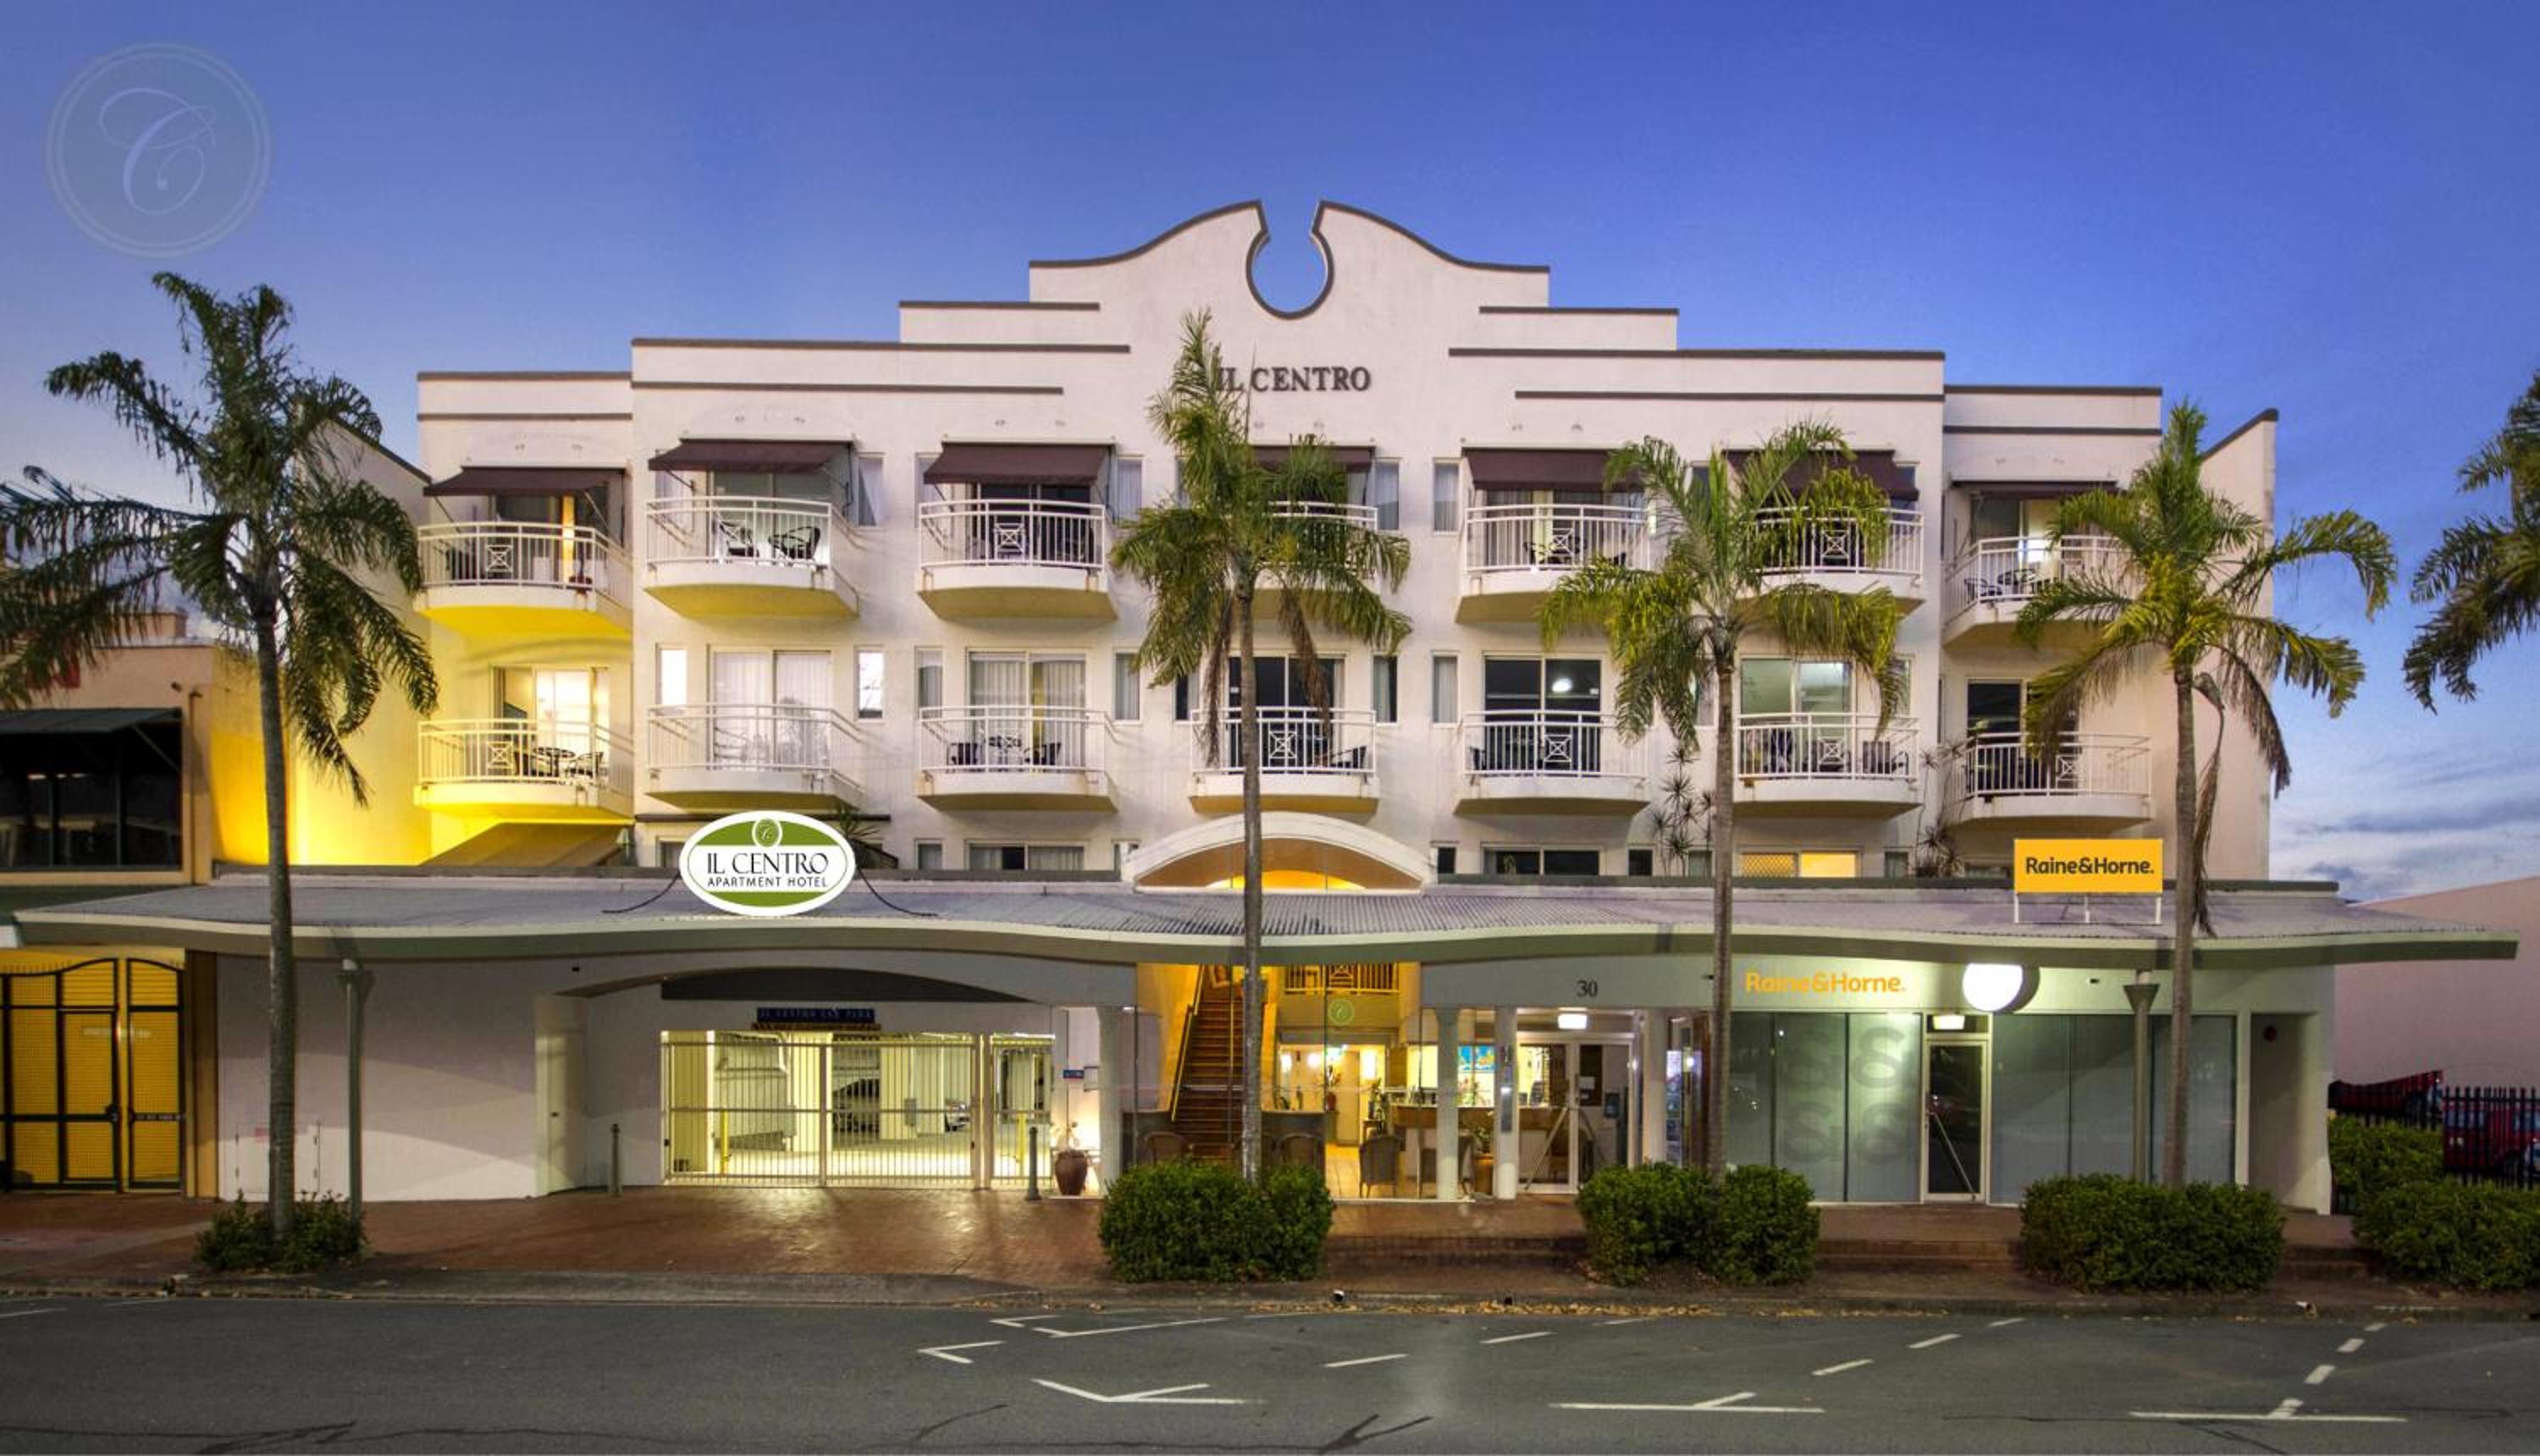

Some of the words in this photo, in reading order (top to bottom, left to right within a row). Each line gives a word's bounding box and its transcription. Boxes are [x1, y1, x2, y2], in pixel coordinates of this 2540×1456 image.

[1218, 367, 1245, 392] IL
[1250, 366, 1372, 392] CENTRO
[707, 852, 726, 874] IL
[732, 852, 830, 874] CENTRO
[2026, 857, 2155, 874] Raine&Horne.
[707, 877, 782, 888] APARTMENT
[787, 877, 827, 888] HOTEL
[1575, 979, 1599, 998] 30
